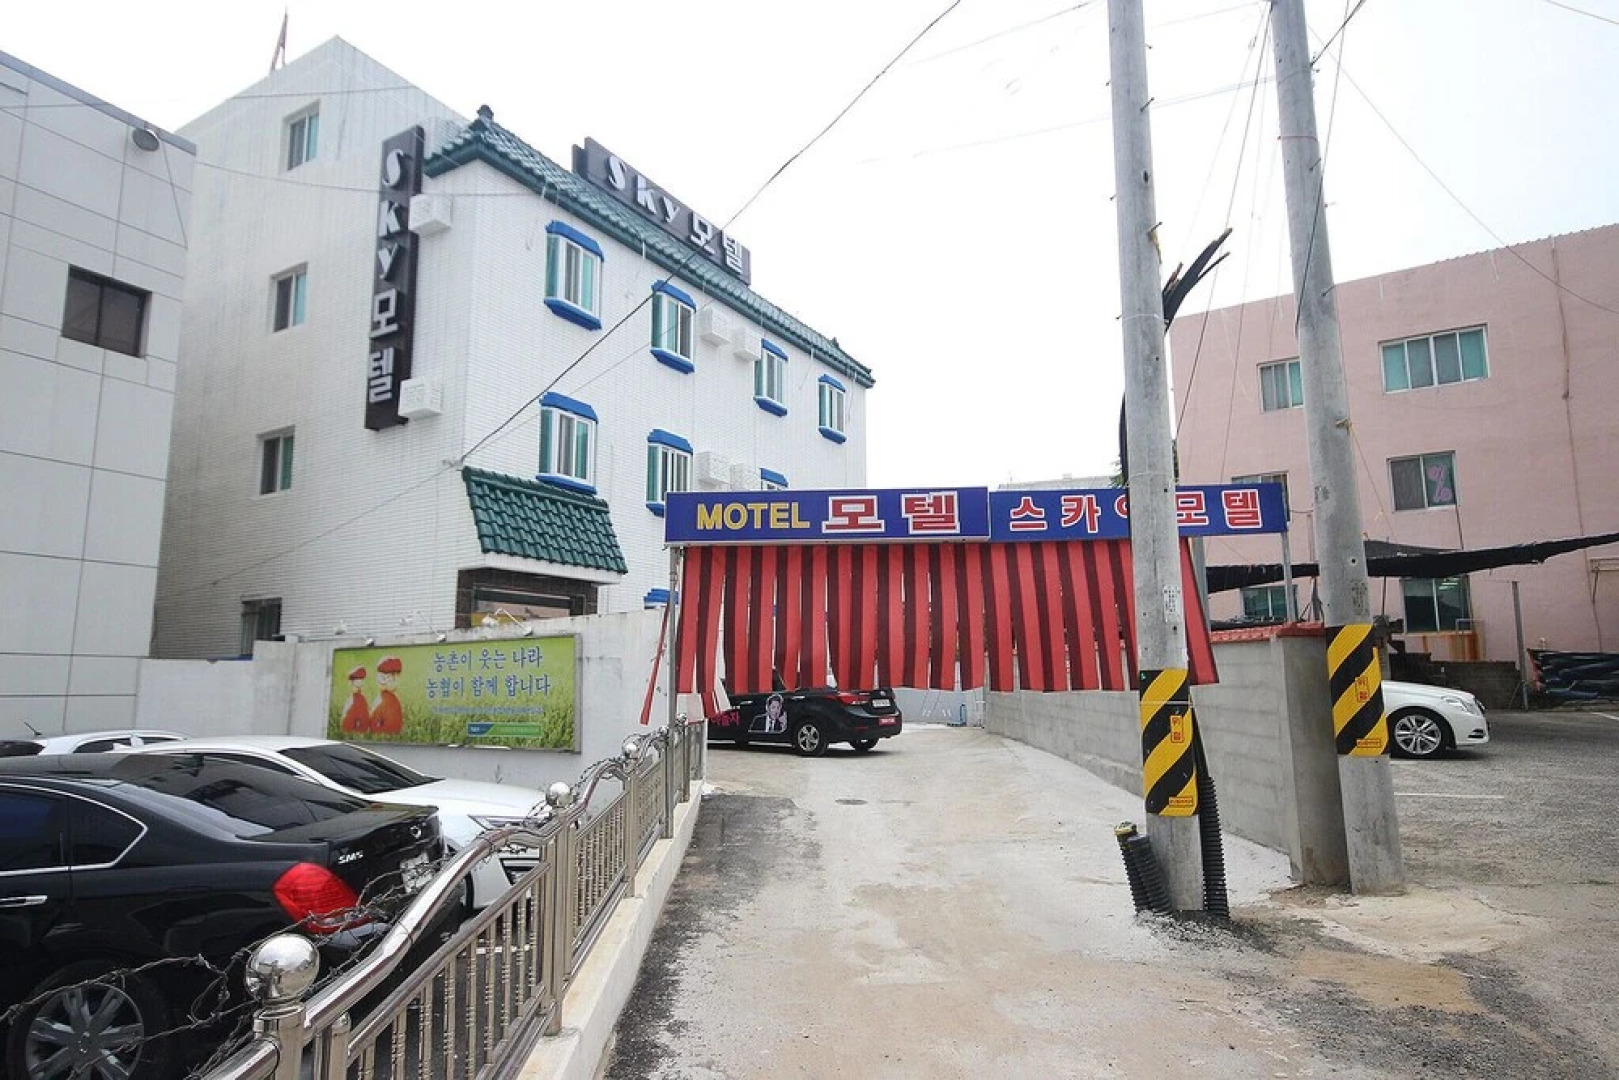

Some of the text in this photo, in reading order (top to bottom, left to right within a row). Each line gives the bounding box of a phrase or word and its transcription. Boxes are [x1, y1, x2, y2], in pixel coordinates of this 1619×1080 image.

[691, 211, 744, 275] 모텔
[369, 287, 399, 403] 모텔
[696, 490, 961, 535] MOTEL 모텔
[433, 646, 543, 673] 농촌이 웃는 나라
[426, 674, 551, 699] 농협이 함께 합니다
